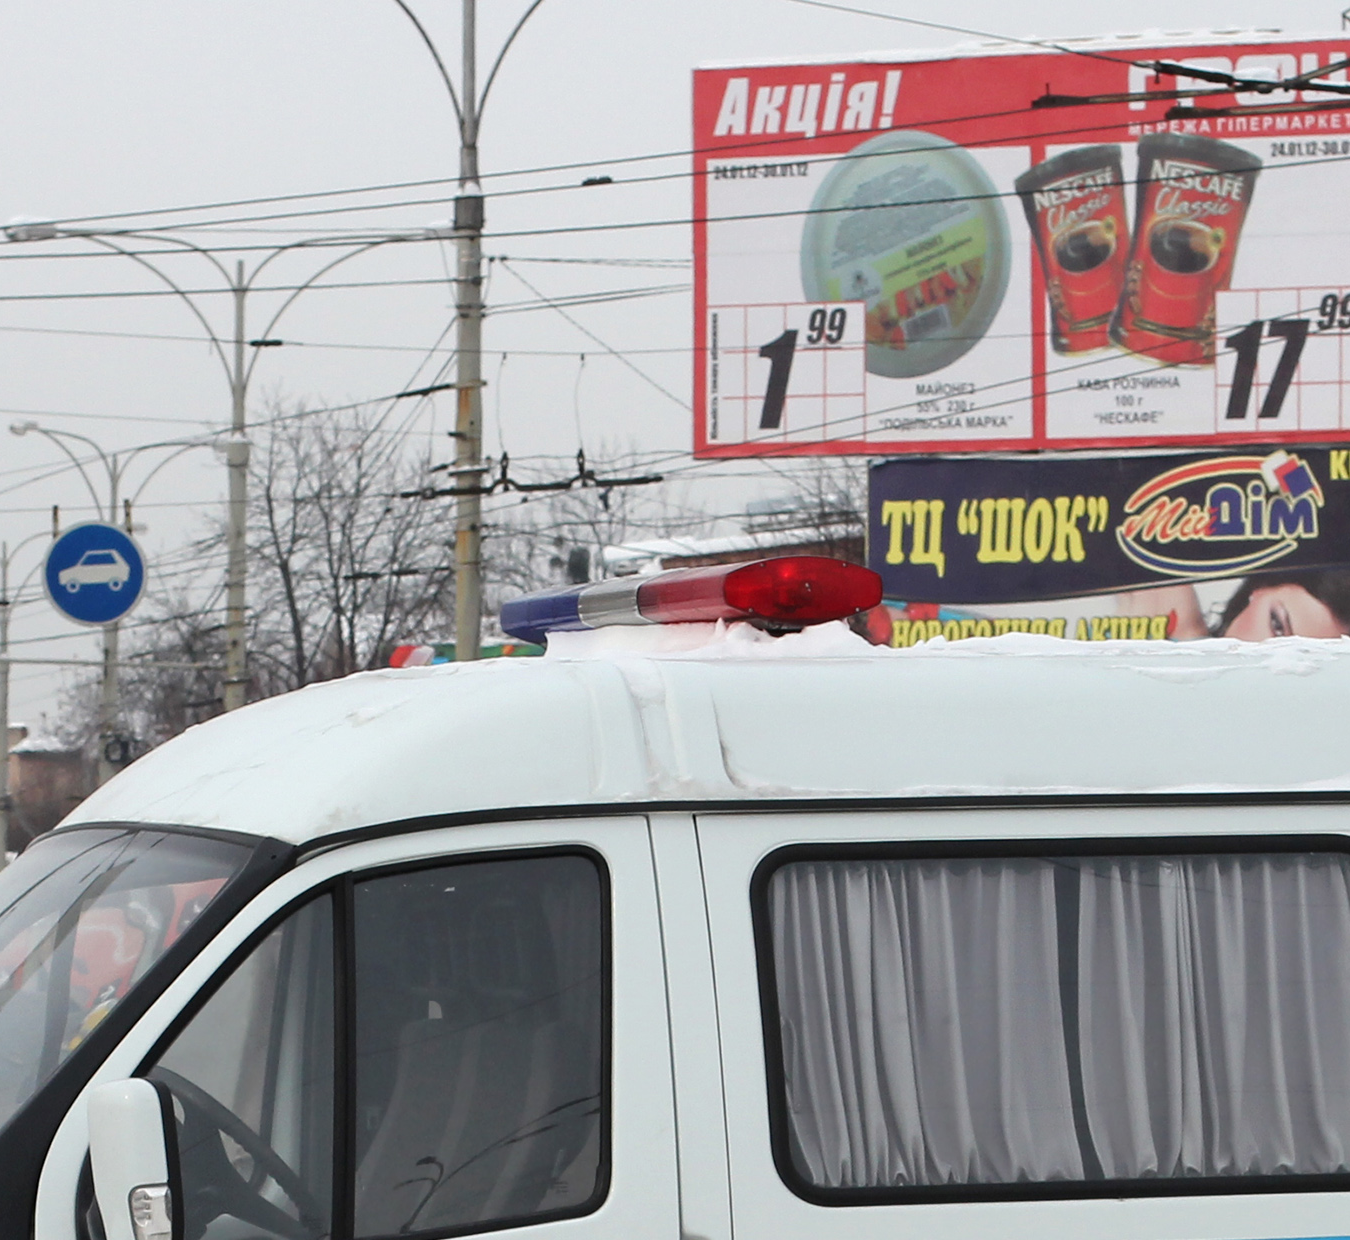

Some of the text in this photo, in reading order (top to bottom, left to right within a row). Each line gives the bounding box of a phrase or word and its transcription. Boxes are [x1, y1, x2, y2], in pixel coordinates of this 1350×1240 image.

[713, 70, 902, 138] Акція!
[1129, 119, 1211, 135] МЕРЕЖА
[1152, 159, 1244, 200] NESCAFÉ
[1154, 187, 1232, 218] Classic
[807, 308, 846, 344] 99
[759, 330, 798, 429] 1
[1225, 319, 1310, 419] 17
[882, 500, 945, 578] ТЦ
